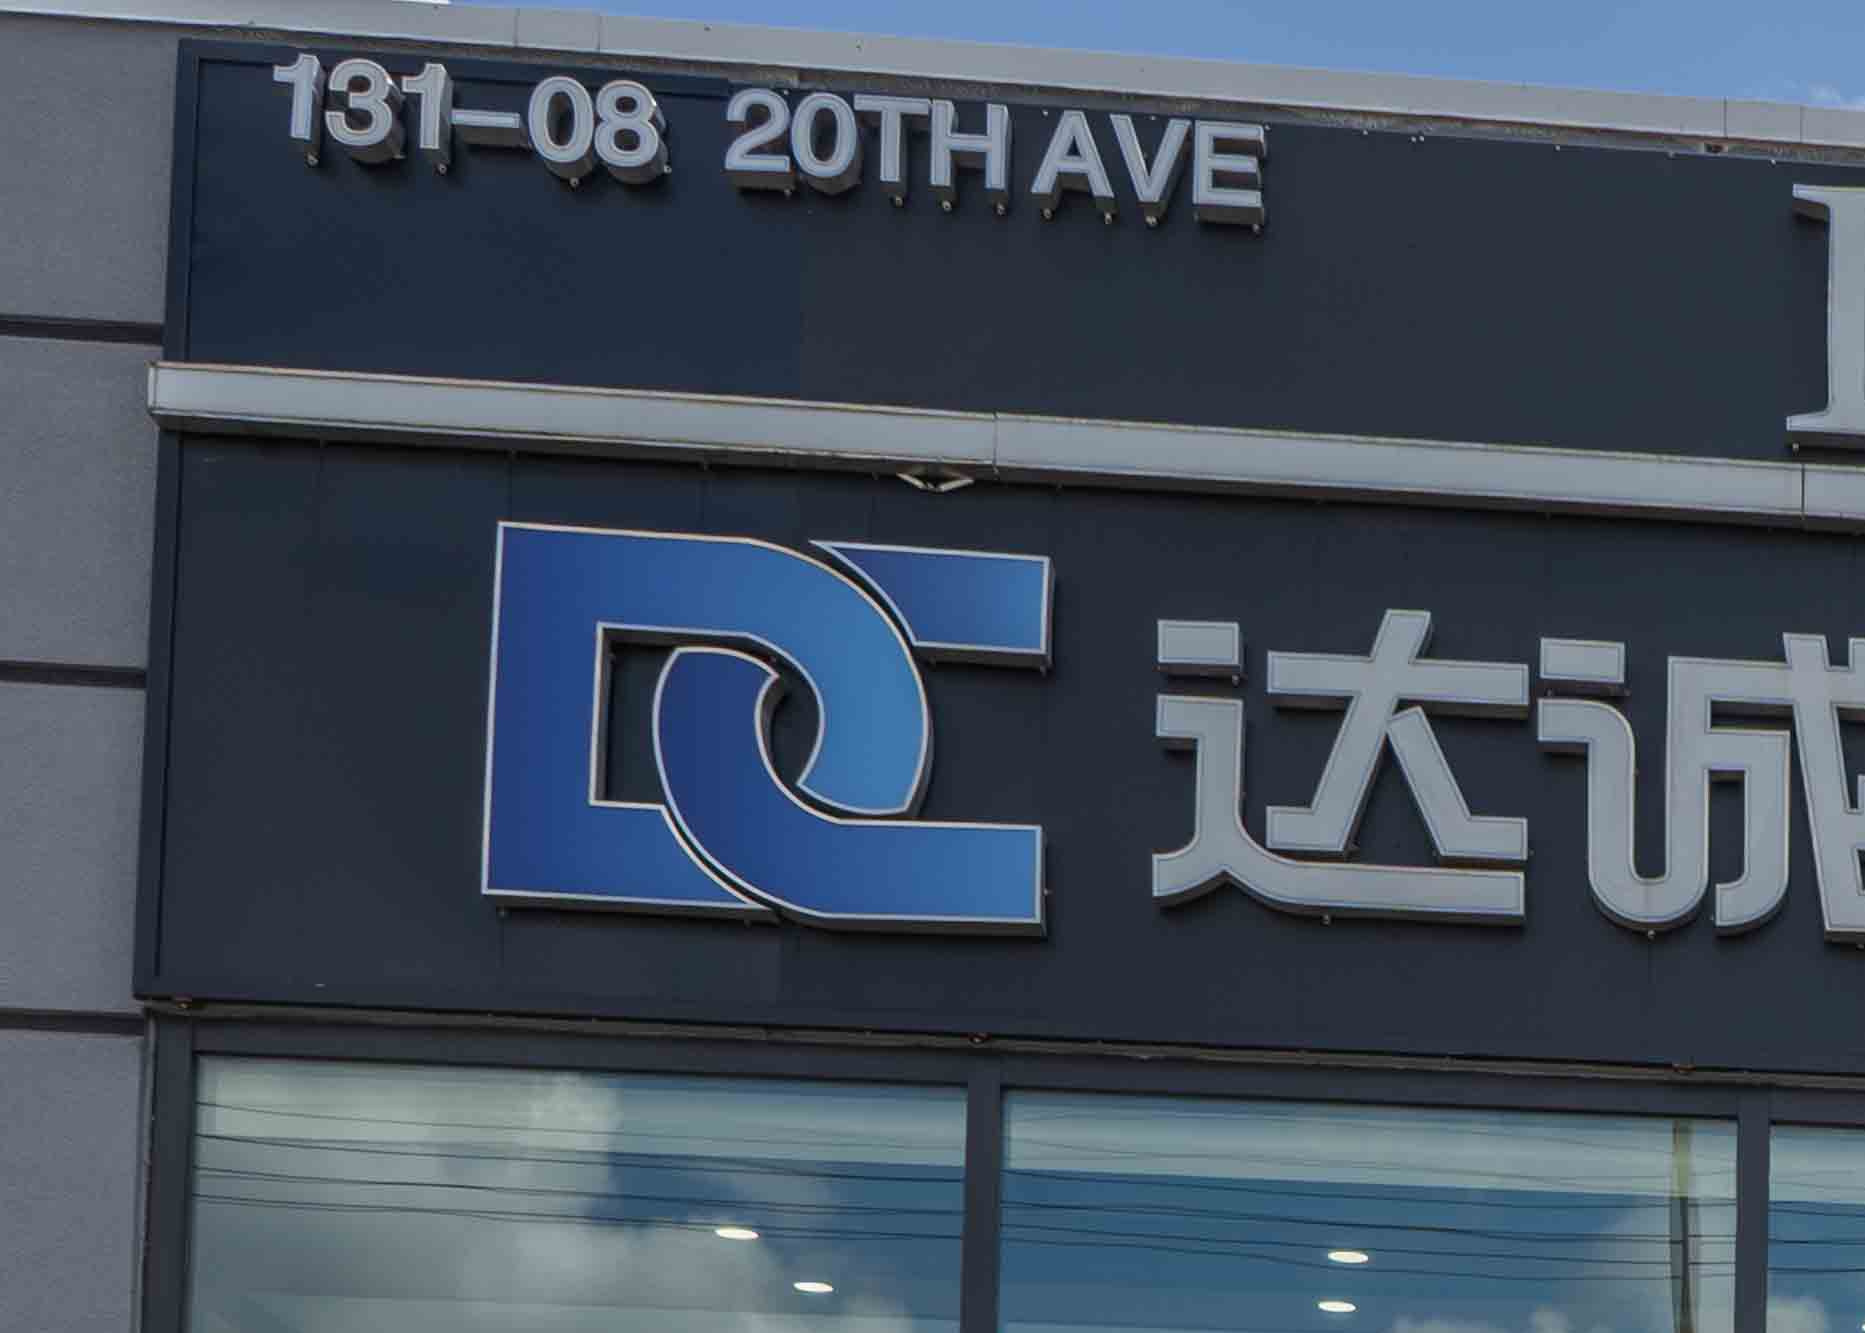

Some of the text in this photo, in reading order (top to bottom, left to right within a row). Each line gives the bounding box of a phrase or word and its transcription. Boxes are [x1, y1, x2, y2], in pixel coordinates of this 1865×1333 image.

[722, 88, 1010, 213] 20TH
[1031, 111, 1268, 228] AVE
[482, 522, 1054, 936] DC
